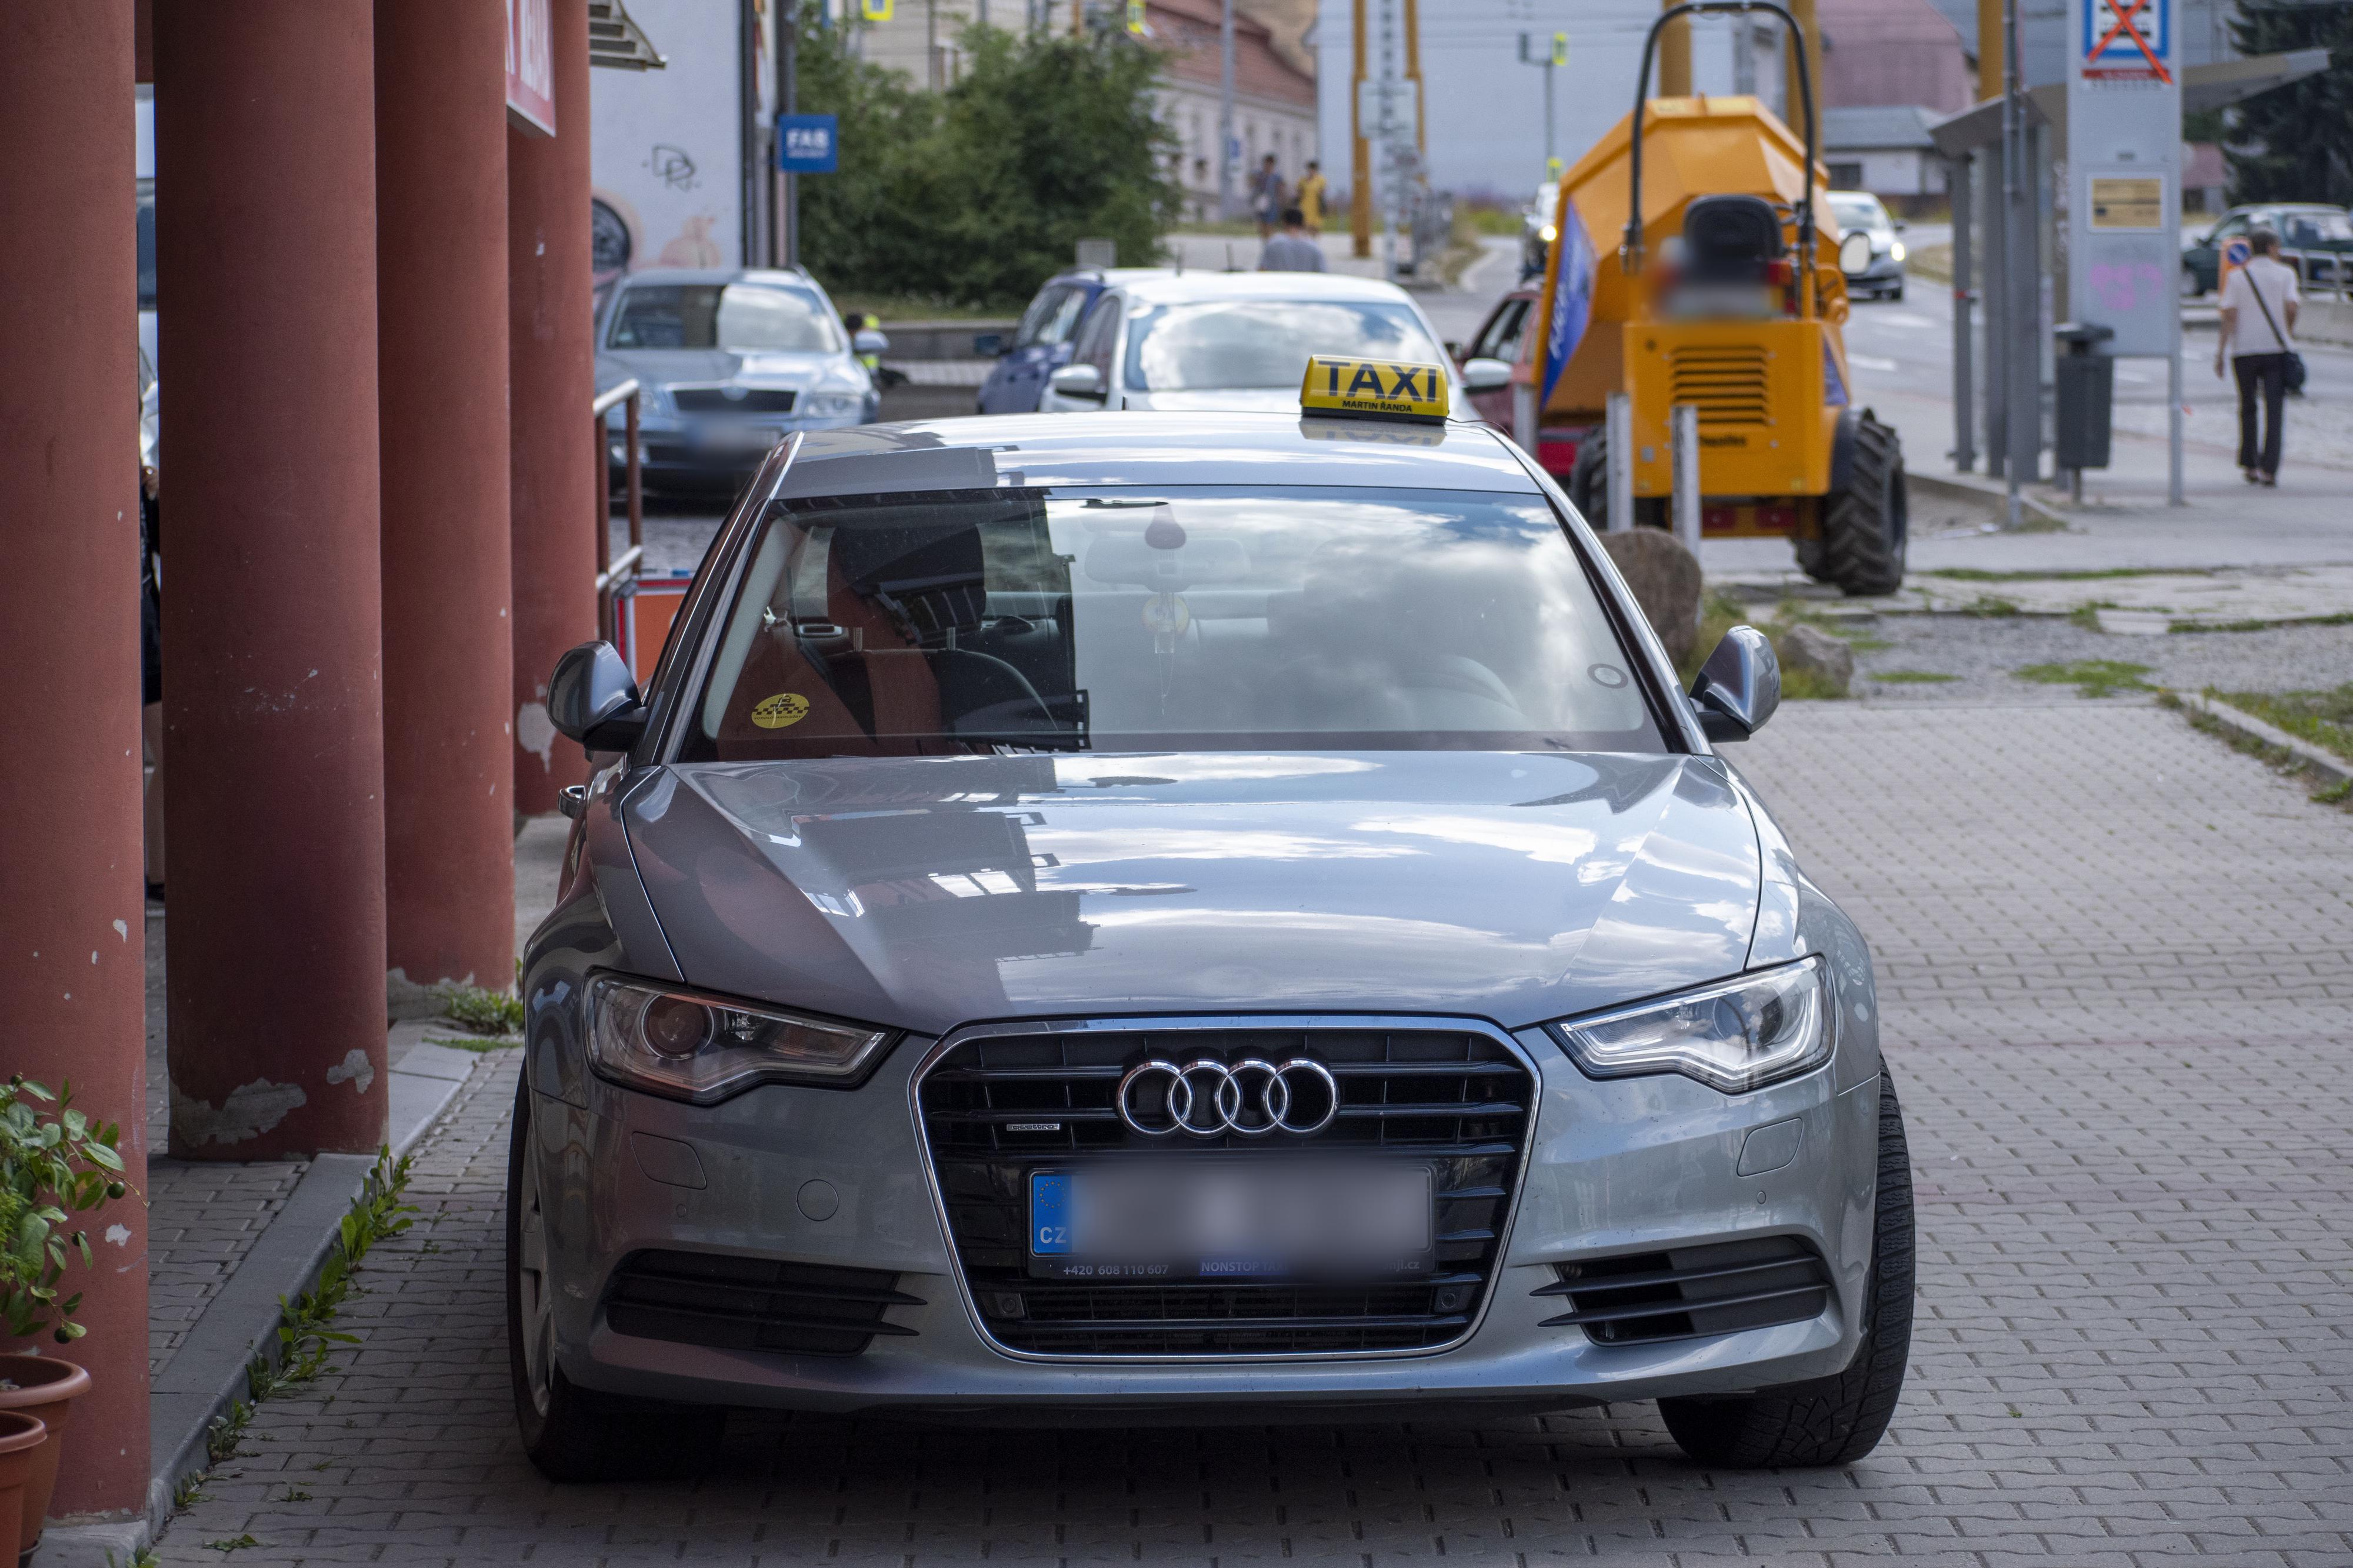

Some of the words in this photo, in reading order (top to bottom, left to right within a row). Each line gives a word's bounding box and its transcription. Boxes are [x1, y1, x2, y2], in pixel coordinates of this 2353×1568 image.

[1318, 360, 1436, 402] TAXI
[1342, 401, 1378, 410] MARTIN
[1040, 1226, 1066, 1244] CZ
[1064, 1265, 1093, 1275] +420
[1098, 1265, 1120, 1275] 608
[1123, 1265, 1144, 1275] 110
[1147, 1265, 1169, 1275] 607
[1201, 1262, 1259, 1272] NONSTOP
